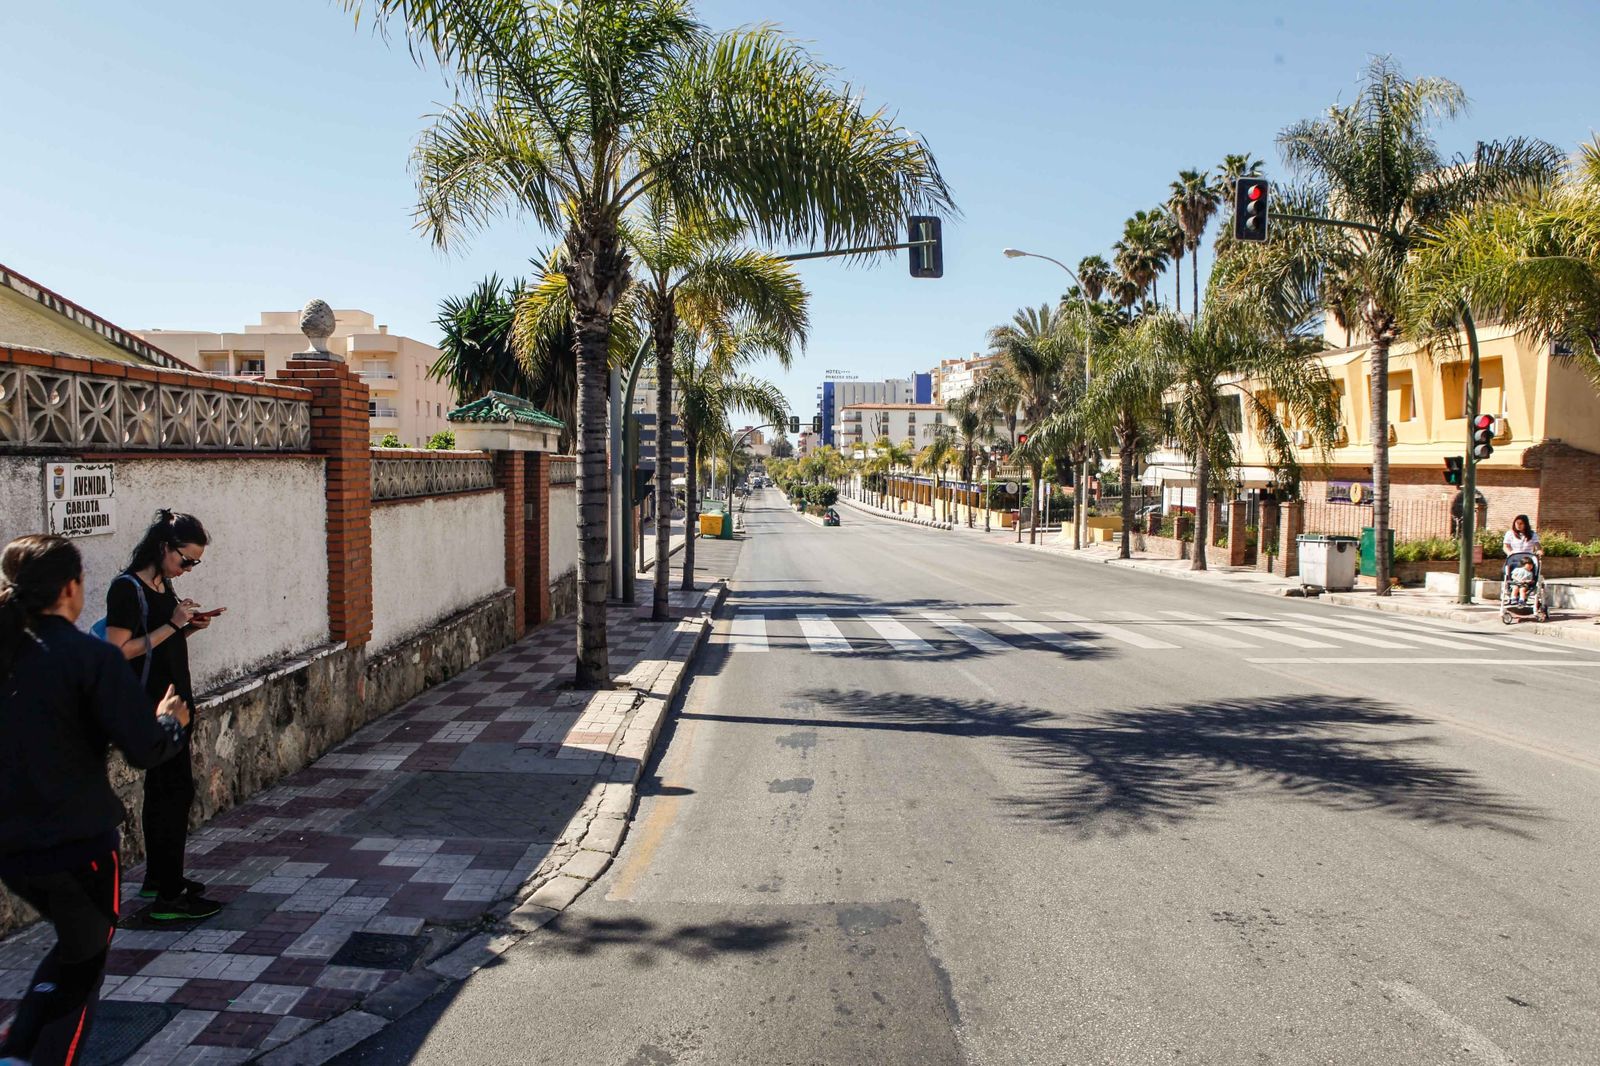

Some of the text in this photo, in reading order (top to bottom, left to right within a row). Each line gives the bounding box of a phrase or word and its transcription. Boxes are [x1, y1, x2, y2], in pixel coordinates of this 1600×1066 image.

[73, 475, 107, 496] AVENIDA
[66, 500, 100, 515] CARLOTA
[63, 514, 110, 530] ALESSANDRI
